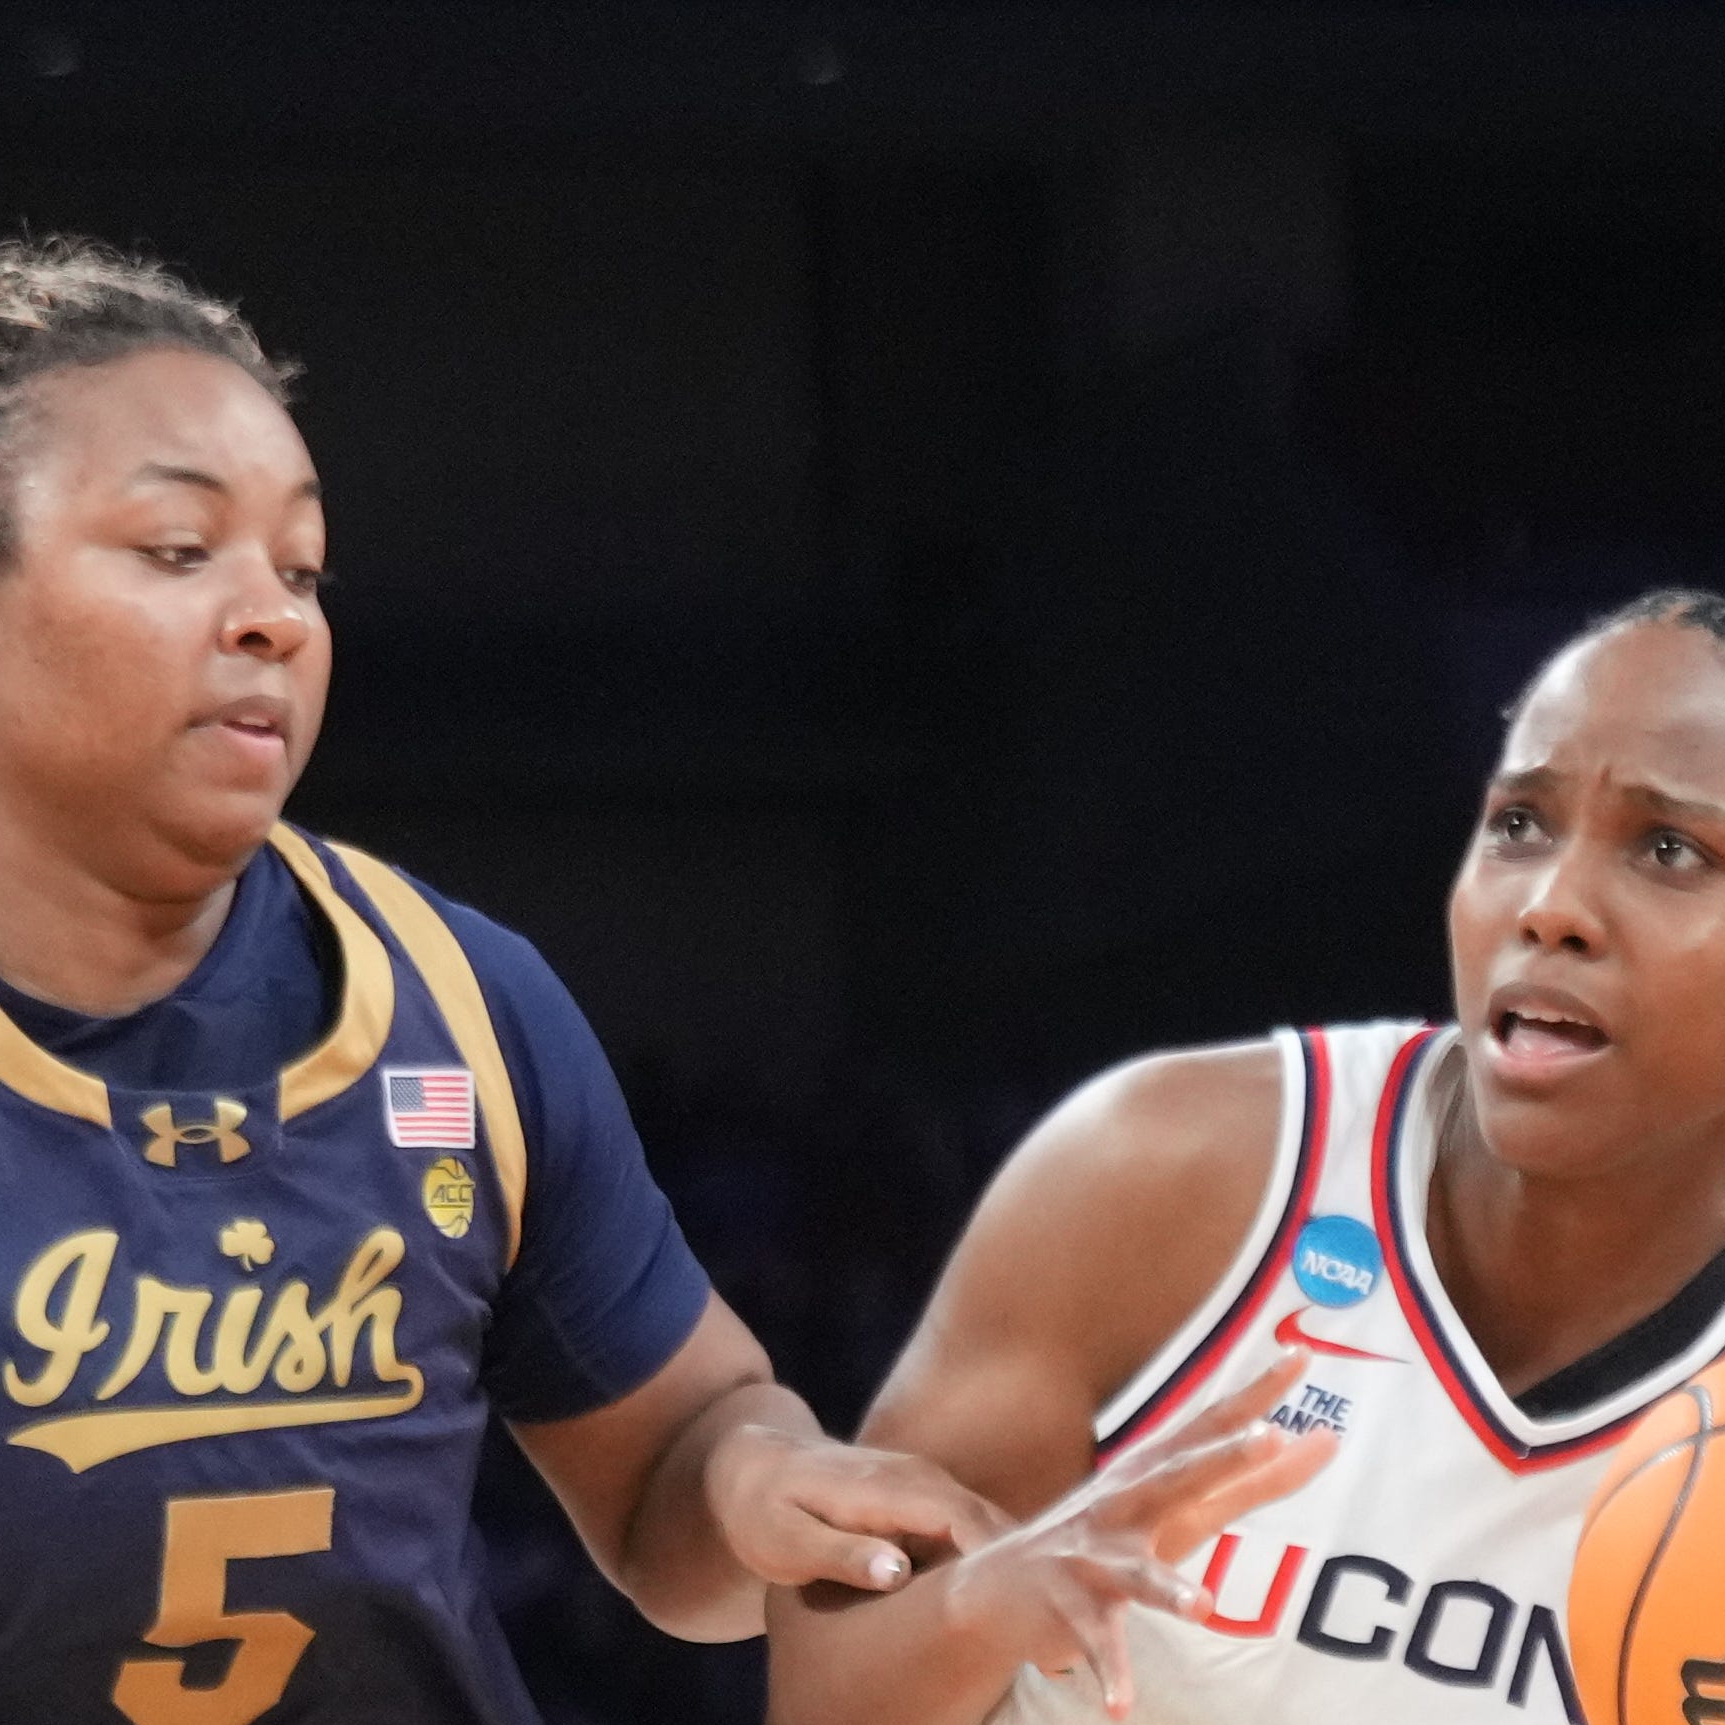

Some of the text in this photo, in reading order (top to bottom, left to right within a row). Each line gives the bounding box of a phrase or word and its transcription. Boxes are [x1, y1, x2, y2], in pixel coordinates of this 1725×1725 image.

[431, 1183, 475, 1203] ACC
[1302, 1248, 1373, 1296] NCAA
[4, 1229, 425, 1410] Irish
[1299, 1384, 1354, 1422] THE
